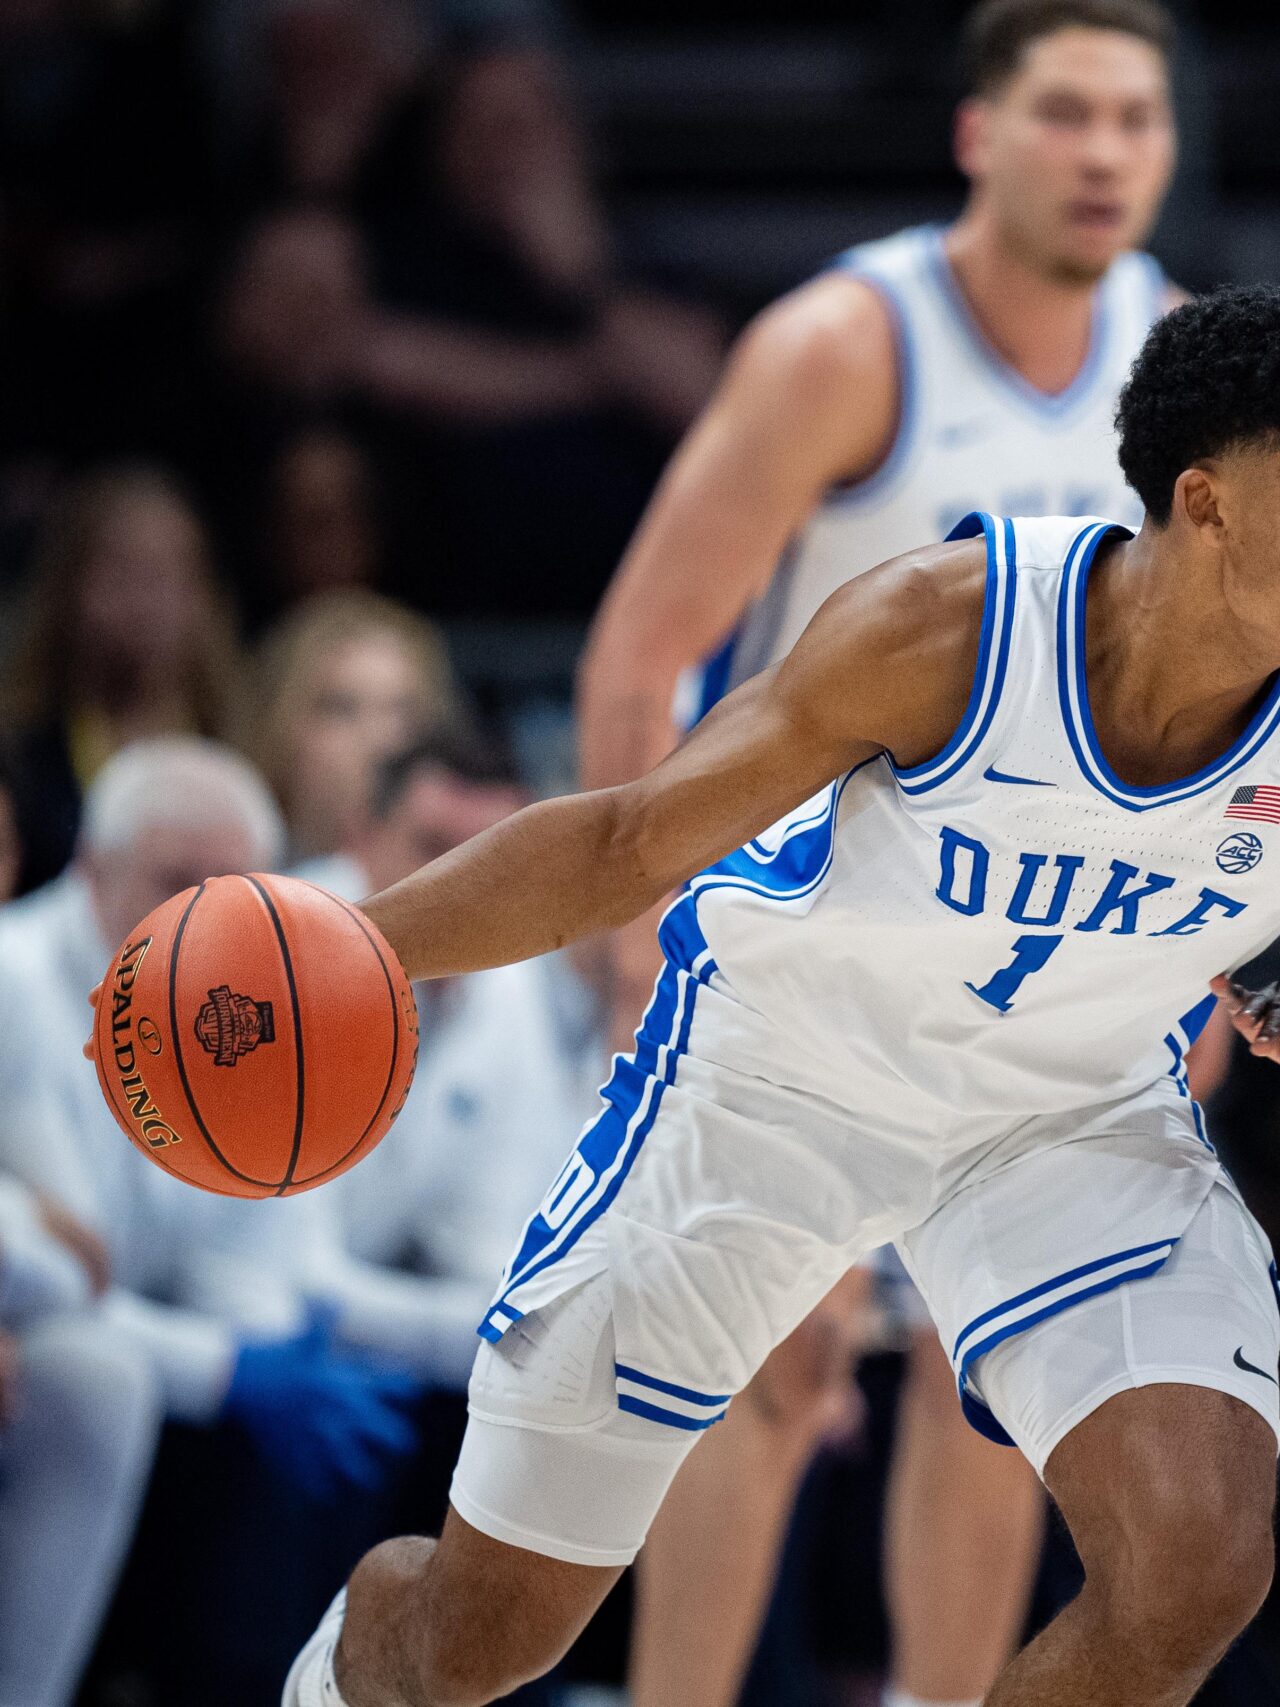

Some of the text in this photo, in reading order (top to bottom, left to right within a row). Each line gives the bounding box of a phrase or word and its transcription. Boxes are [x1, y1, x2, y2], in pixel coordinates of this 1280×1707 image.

[935, 825, 1249, 937] DUKE
[964, 934, 1064, 1015] 1
[112, 934, 182, 1149] SPALDING
[212, 985, 236, 1065] TOURNAMENT
